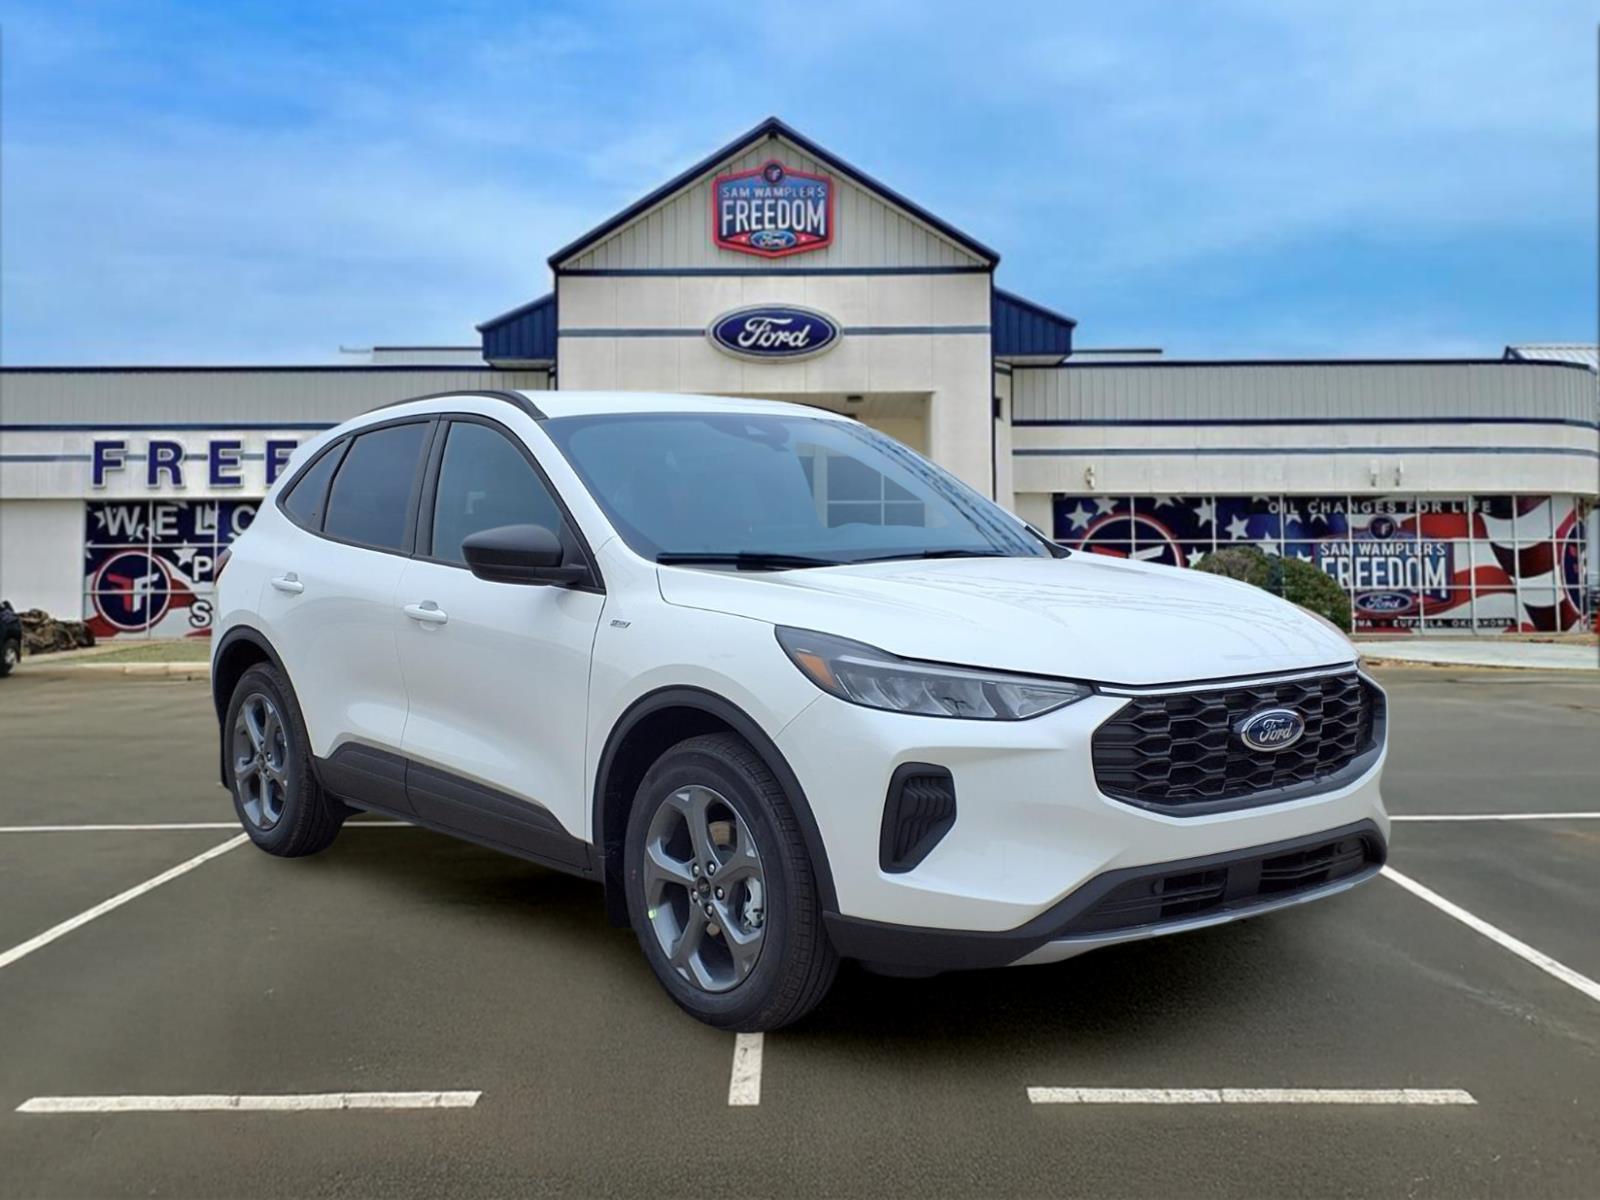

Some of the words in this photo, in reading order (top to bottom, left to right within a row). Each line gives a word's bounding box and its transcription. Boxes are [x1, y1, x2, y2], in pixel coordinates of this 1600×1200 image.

[722, 187, 750, 198] SAM
[722, 199, 826, 236] FREEDOM
[737, 316, 811, 348] Ford
[1268, 501, 1299, 514] OIL
[1307, 501, 1397, 514] CHANGES
[1405, 501, 1443, 514] FOR
[1451, 501, 1492, 514] LIFE
[1321, 556, 1447, 599] FREEDOM
[1364, 595, 1400, 610] Ford
[1259, 718, 1293, 743] Ford
